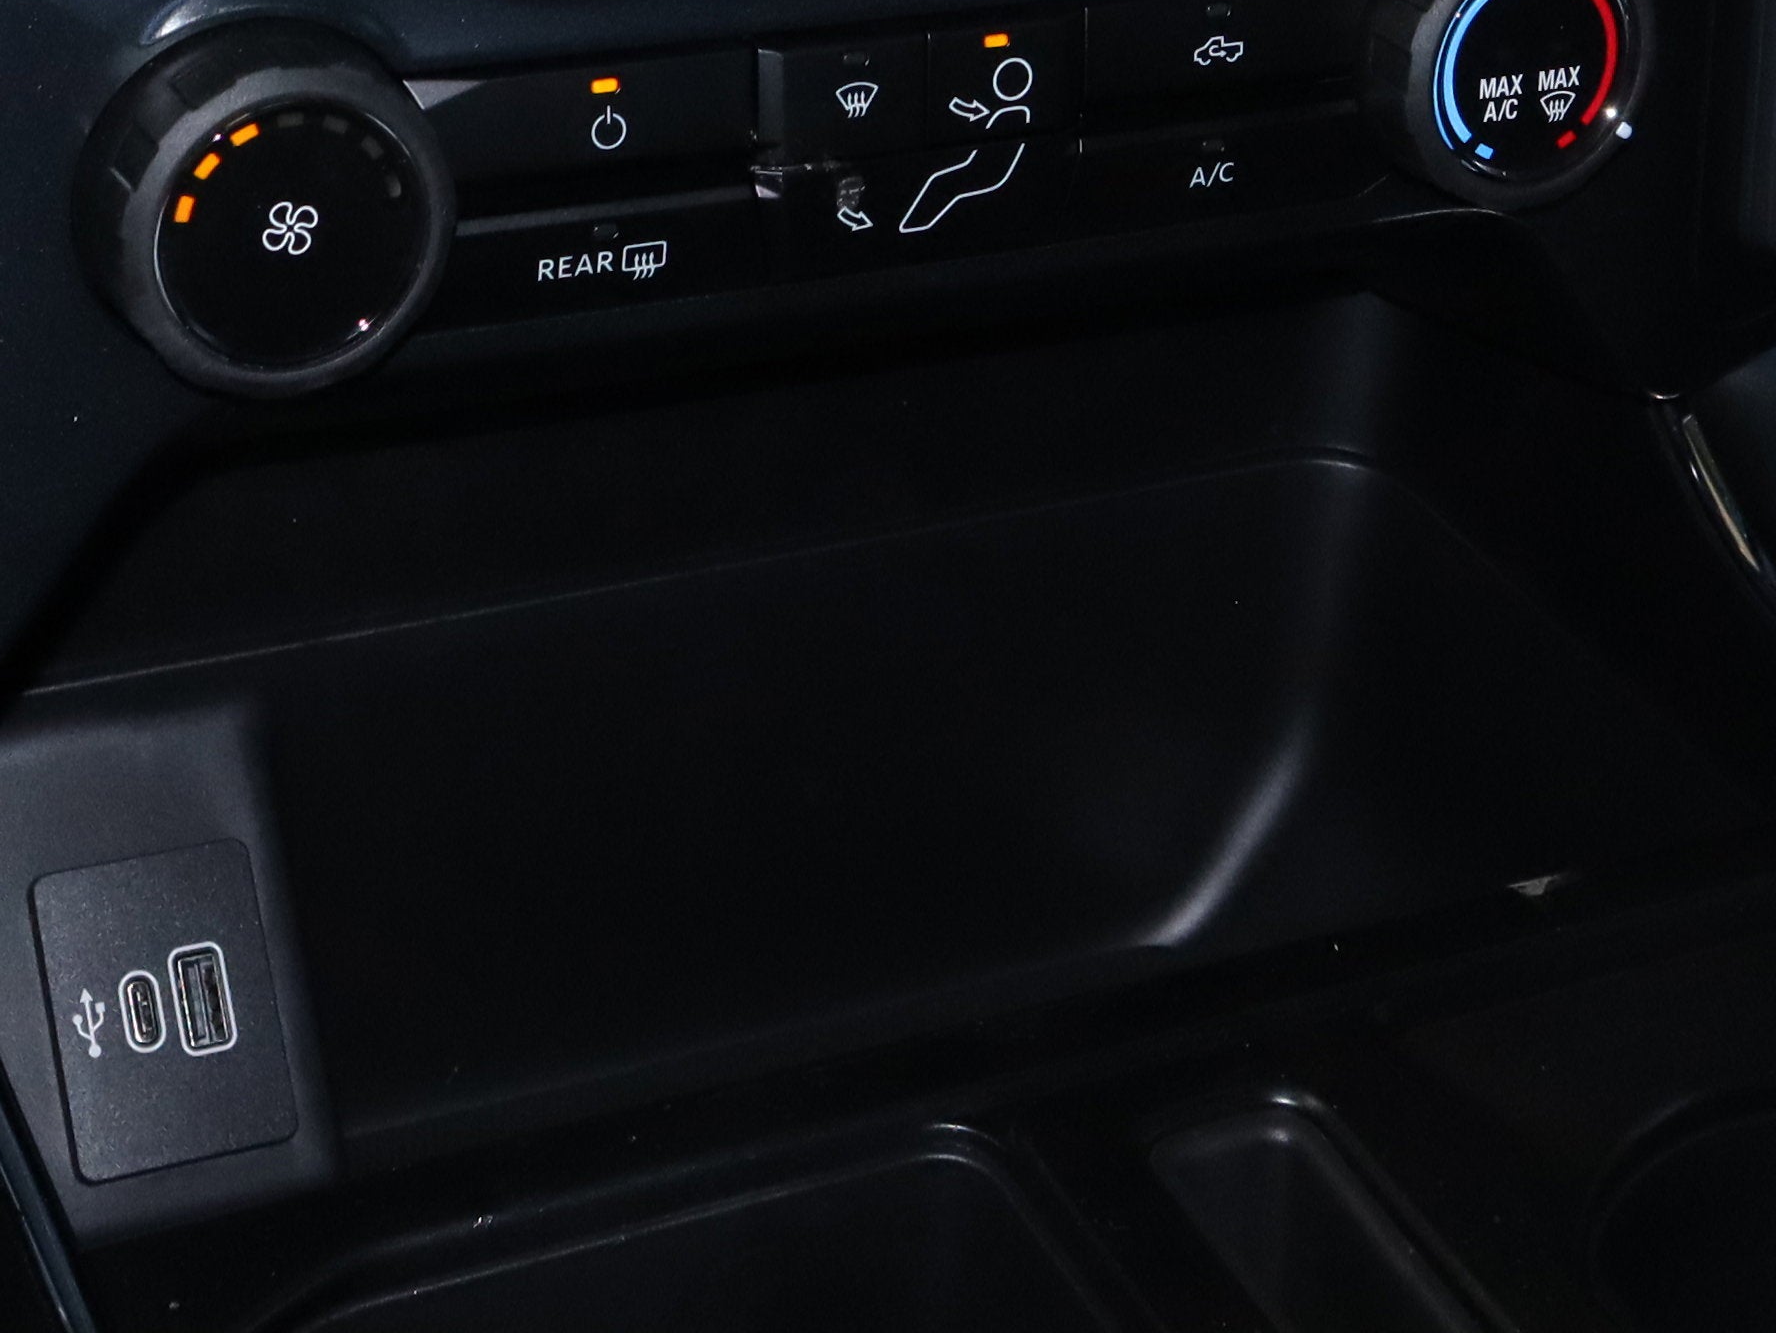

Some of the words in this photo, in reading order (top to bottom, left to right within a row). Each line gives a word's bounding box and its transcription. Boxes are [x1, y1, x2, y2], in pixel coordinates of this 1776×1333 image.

[1479, 73, 1524, 100] MAX
[1537, 65, 1581, 92] MAX
[1483, 98, 1519, 123] A/C
[1189, 162, 1235, 188] A/C
[537, 249, 615, 282] REAR
